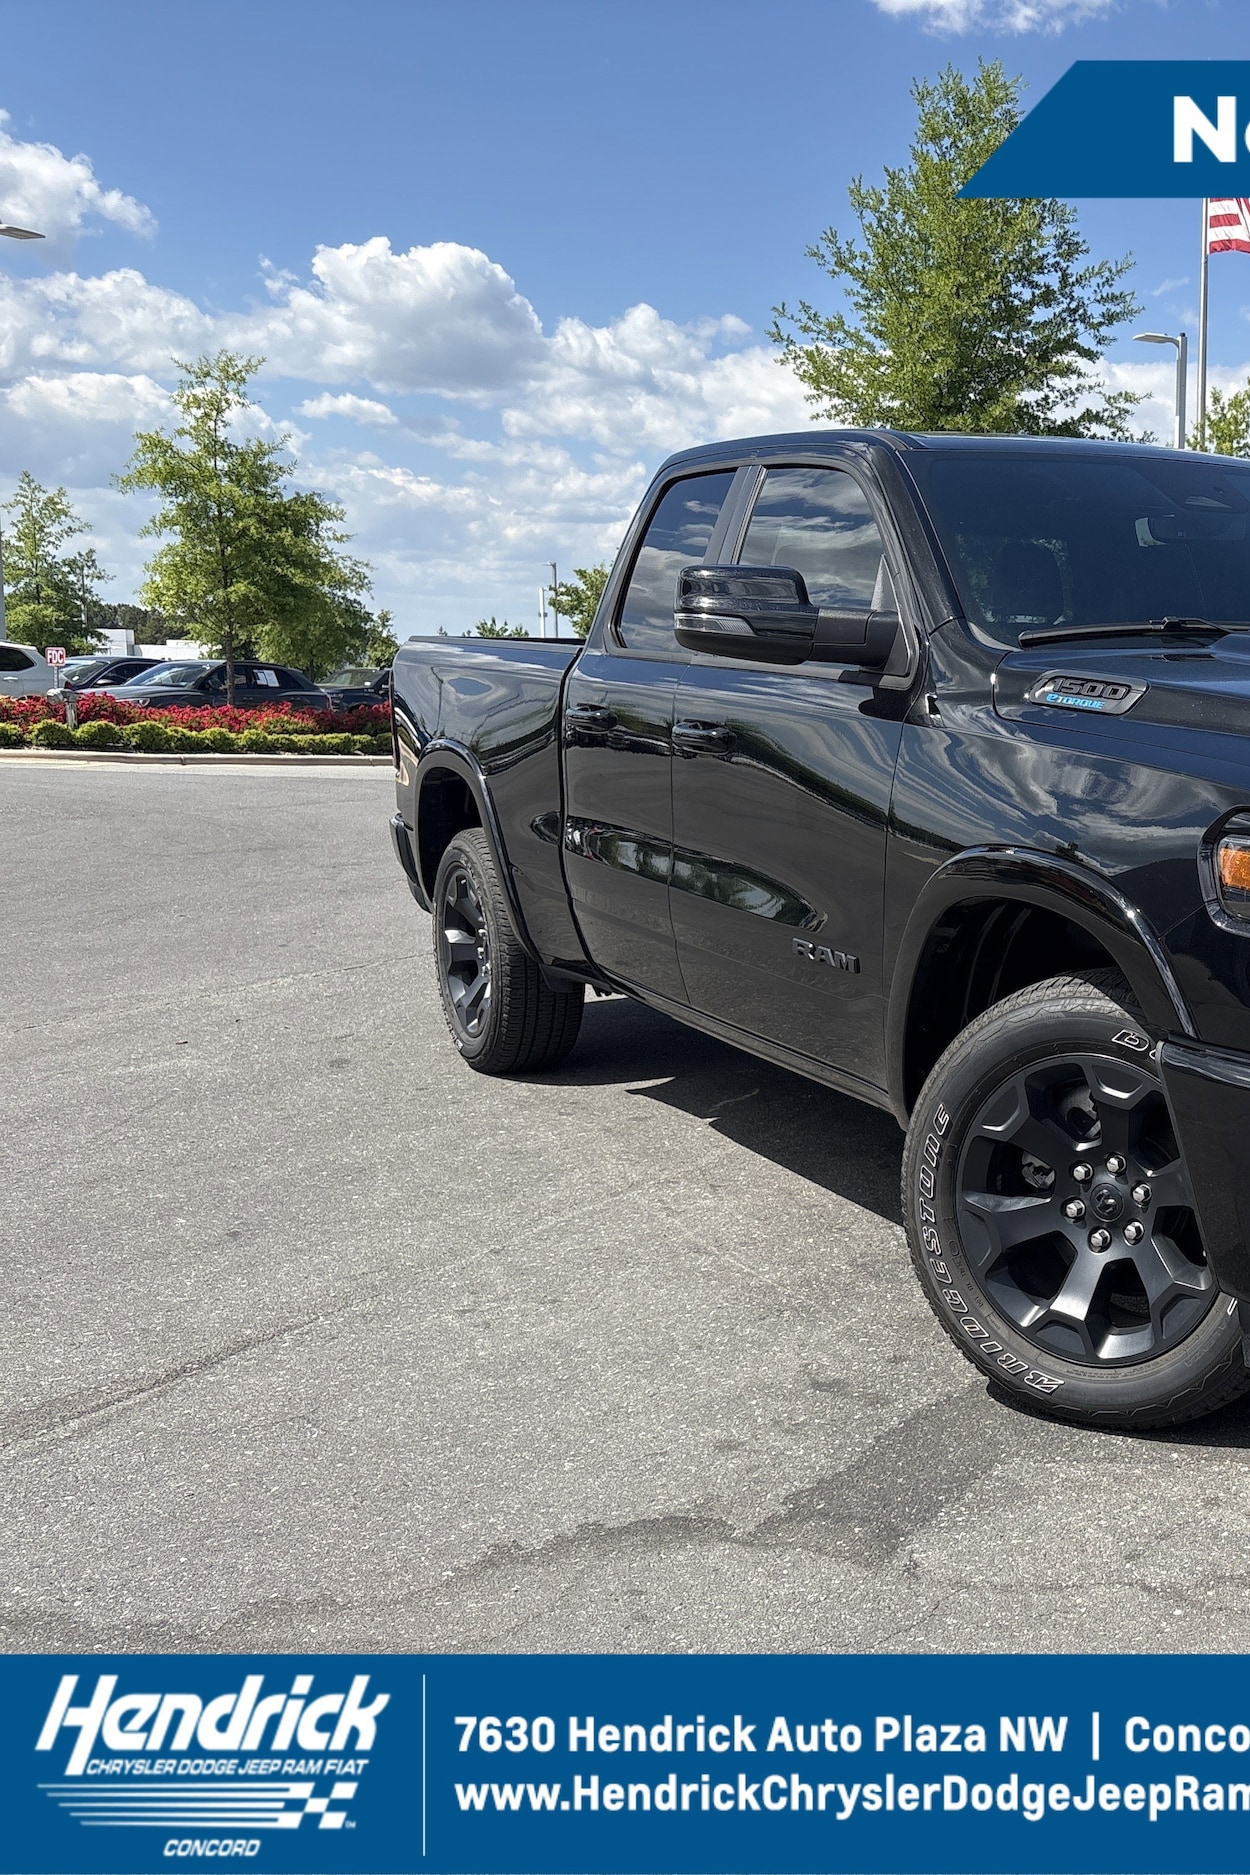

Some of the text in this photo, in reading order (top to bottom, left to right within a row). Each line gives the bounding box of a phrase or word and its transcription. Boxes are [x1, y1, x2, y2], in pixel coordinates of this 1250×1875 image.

[47, 650, 64, 664] FDC
[1052, 677, 1133, 700] 1500
[792, 937, 861, 974] RAM
[918, 1103, 1066, 1394] BRIDGESTONE
